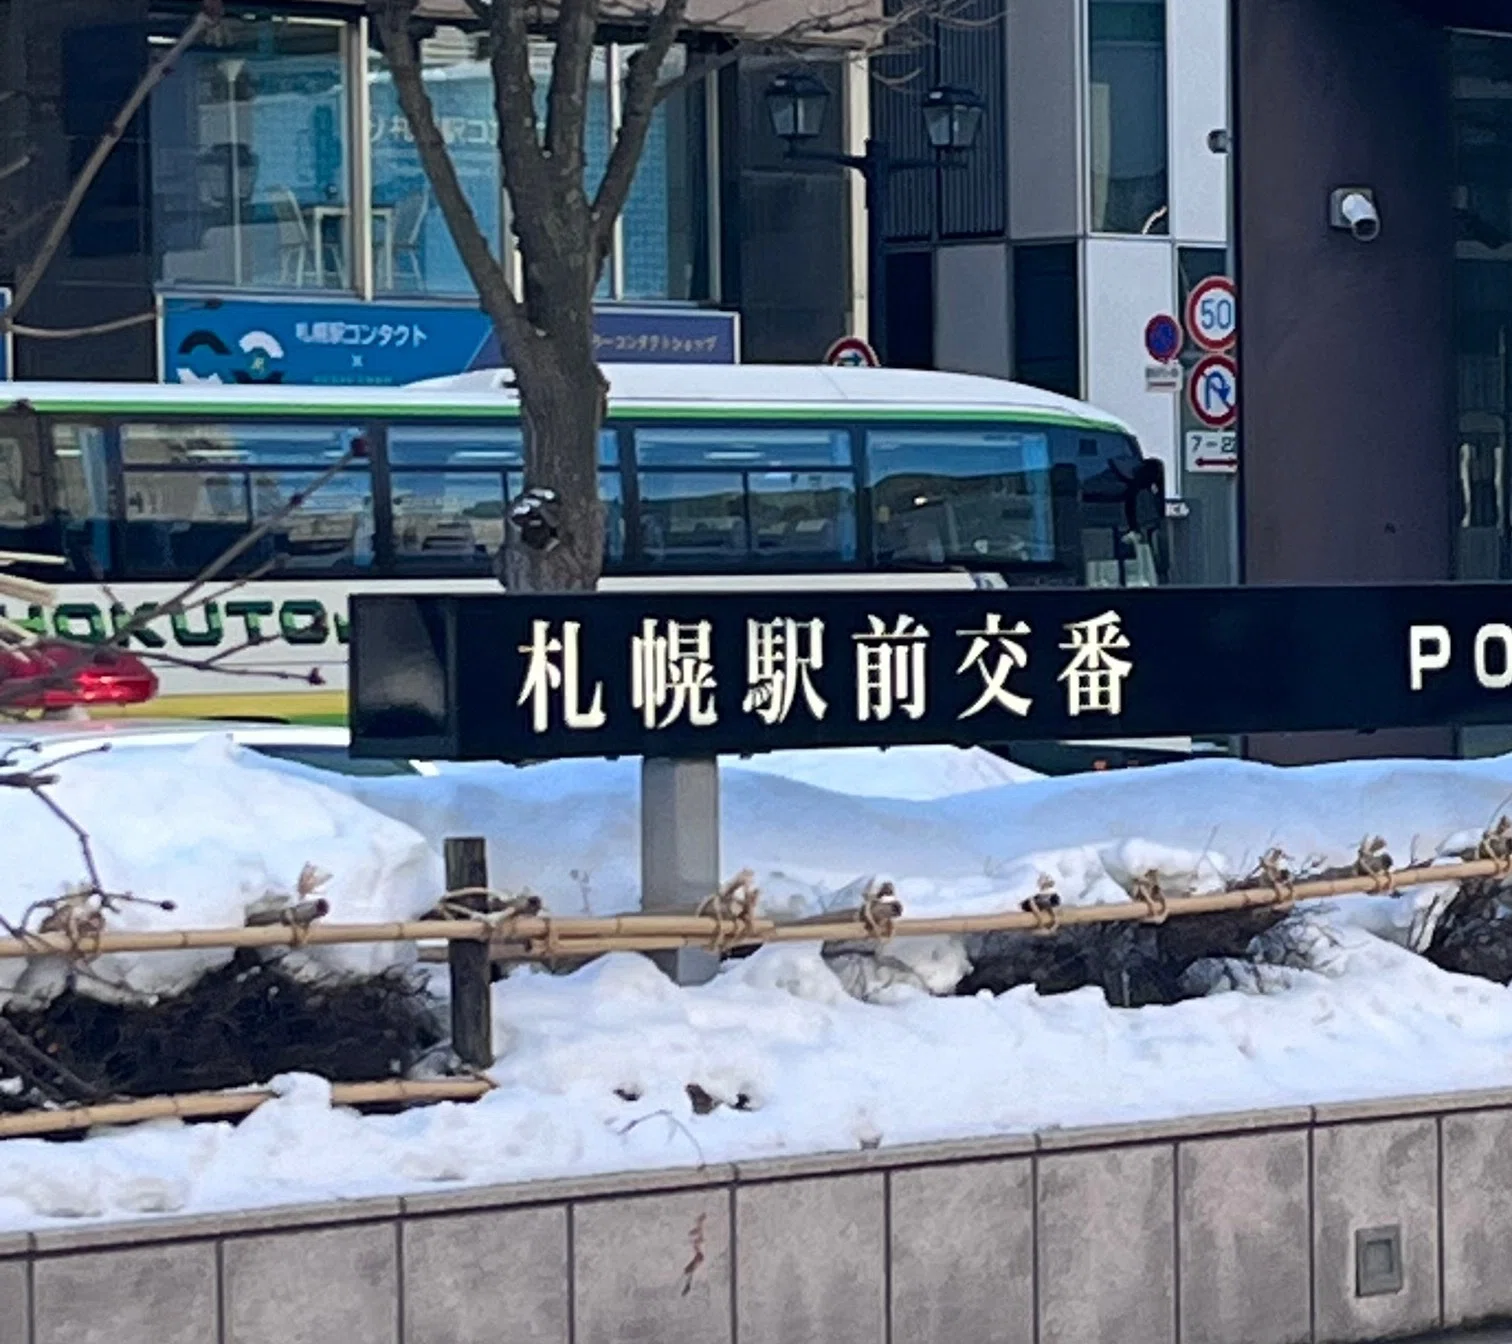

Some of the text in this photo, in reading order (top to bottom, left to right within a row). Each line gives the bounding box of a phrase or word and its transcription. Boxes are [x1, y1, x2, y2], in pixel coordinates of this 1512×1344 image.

[1201, 298, 1232, 330] 50
[517, 609, 1133, 733] 札幌駅前交番
